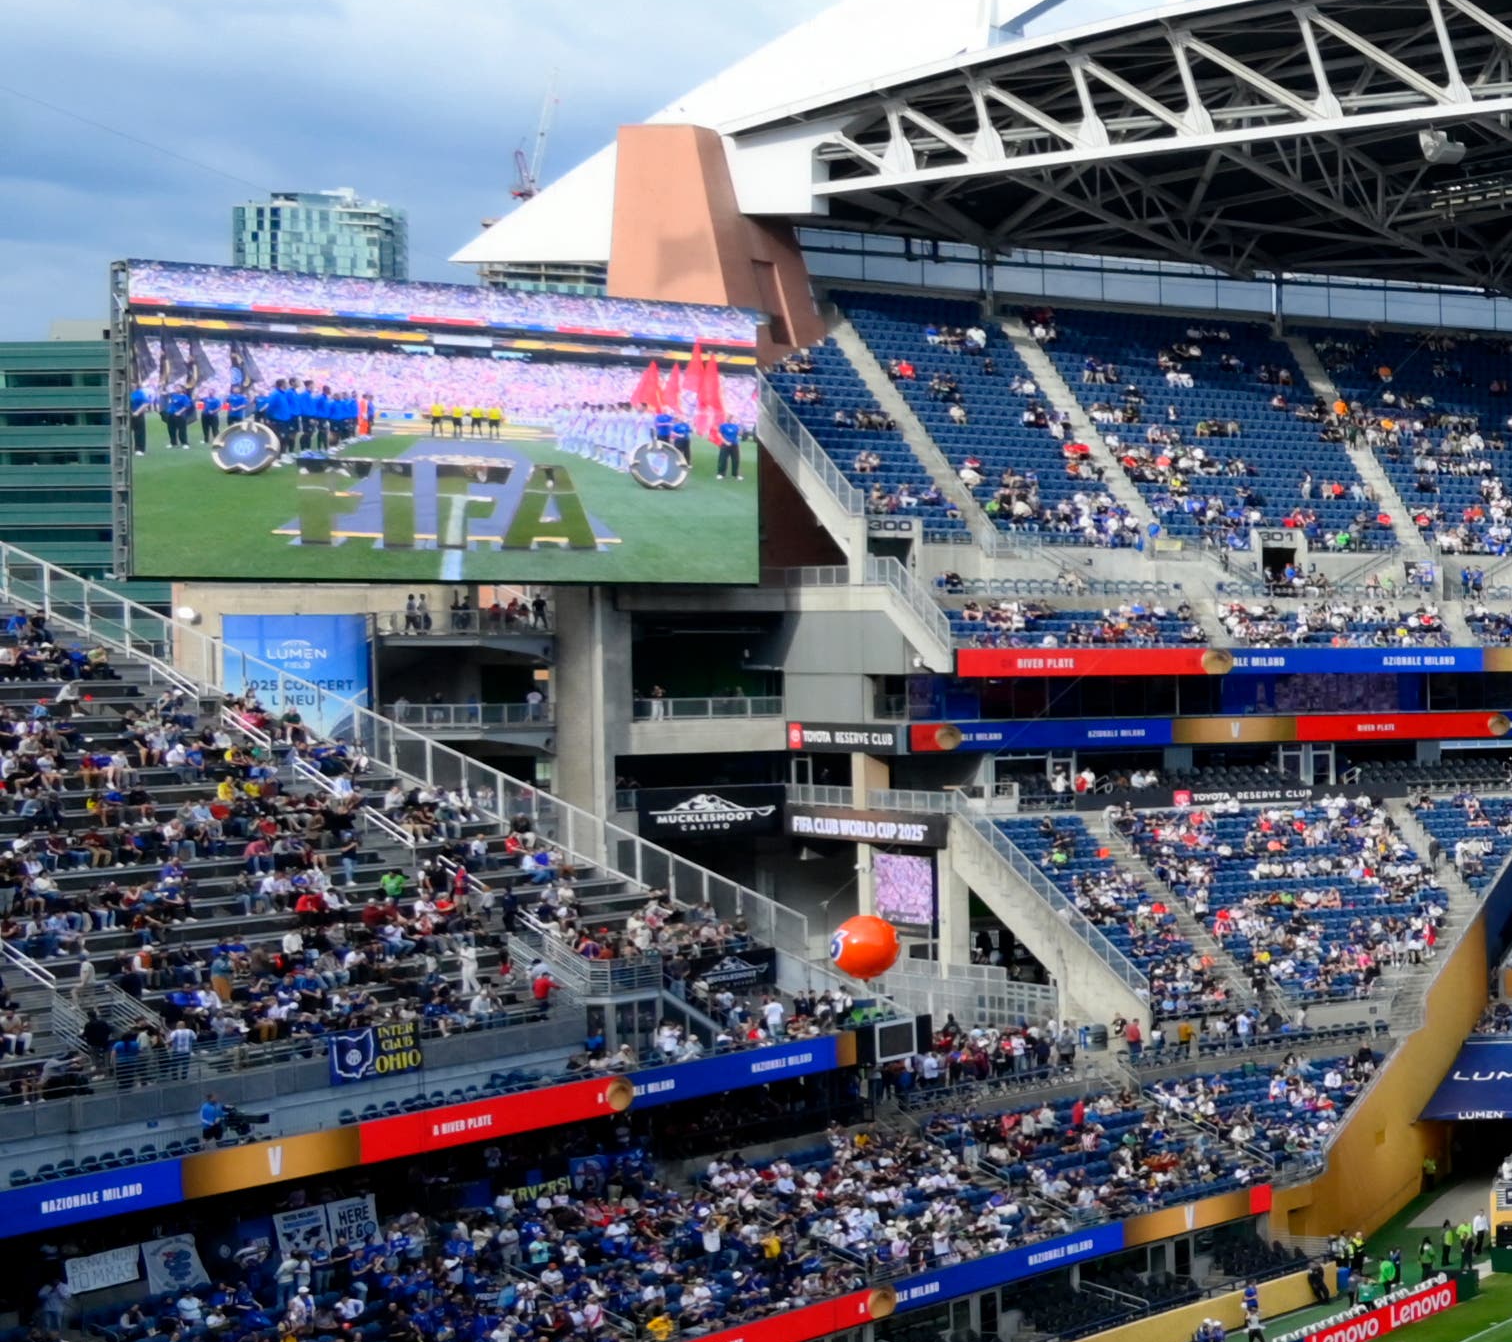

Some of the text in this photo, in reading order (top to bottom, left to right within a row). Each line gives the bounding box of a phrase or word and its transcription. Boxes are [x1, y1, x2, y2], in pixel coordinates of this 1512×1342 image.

[298, 459, 598, 551] FIFA
[869, 519, 911, 531] 300
[1259, 531, 1294, 542] 301
[266, 648, 328, 660] LUMEN
[283, 661, 311, 670] FIELD
[1017, 658, 1074, 669] RIVER PLATE
[802, 730, 894, 746] TOYOTA RESERVE CLUB
[1231, 722, 1240, 738] V
[1193, 788, 1312, 802] TOYOTA RESERVE CLUB
[655, 812, 754, 825] MUCKLESHOOT
[680, 823, 731, 833] CASINO
[792, 815, 815, 833] FIFA
[815, 817, 840, 836] CLUB
[841, 819, 877, 838] WORLD
[877, 821, 898, 839] CUP
[378, 1022, 414, 1038] INTER
[380, 1036, 415, 1051] CLUB
[375, 1048, 422, 1074] OHIO
[751, 1053, 812, 1073] NAZIONALE MILANO
[1457, 1110, 1504, 1120] LUMEN
[433, 1114, 492, 1136] A RIVER PLATE
[268, 1146, 282, 1175] V
[41, 1183, 142, 1213] NAZIONALE MILANO
[338, 1205, 370, 1226] HERE
[1028, 1239, 1093, 1265] NAZIONALE MILANO
[1389, 1286, 1453, 1332] Lenovo
